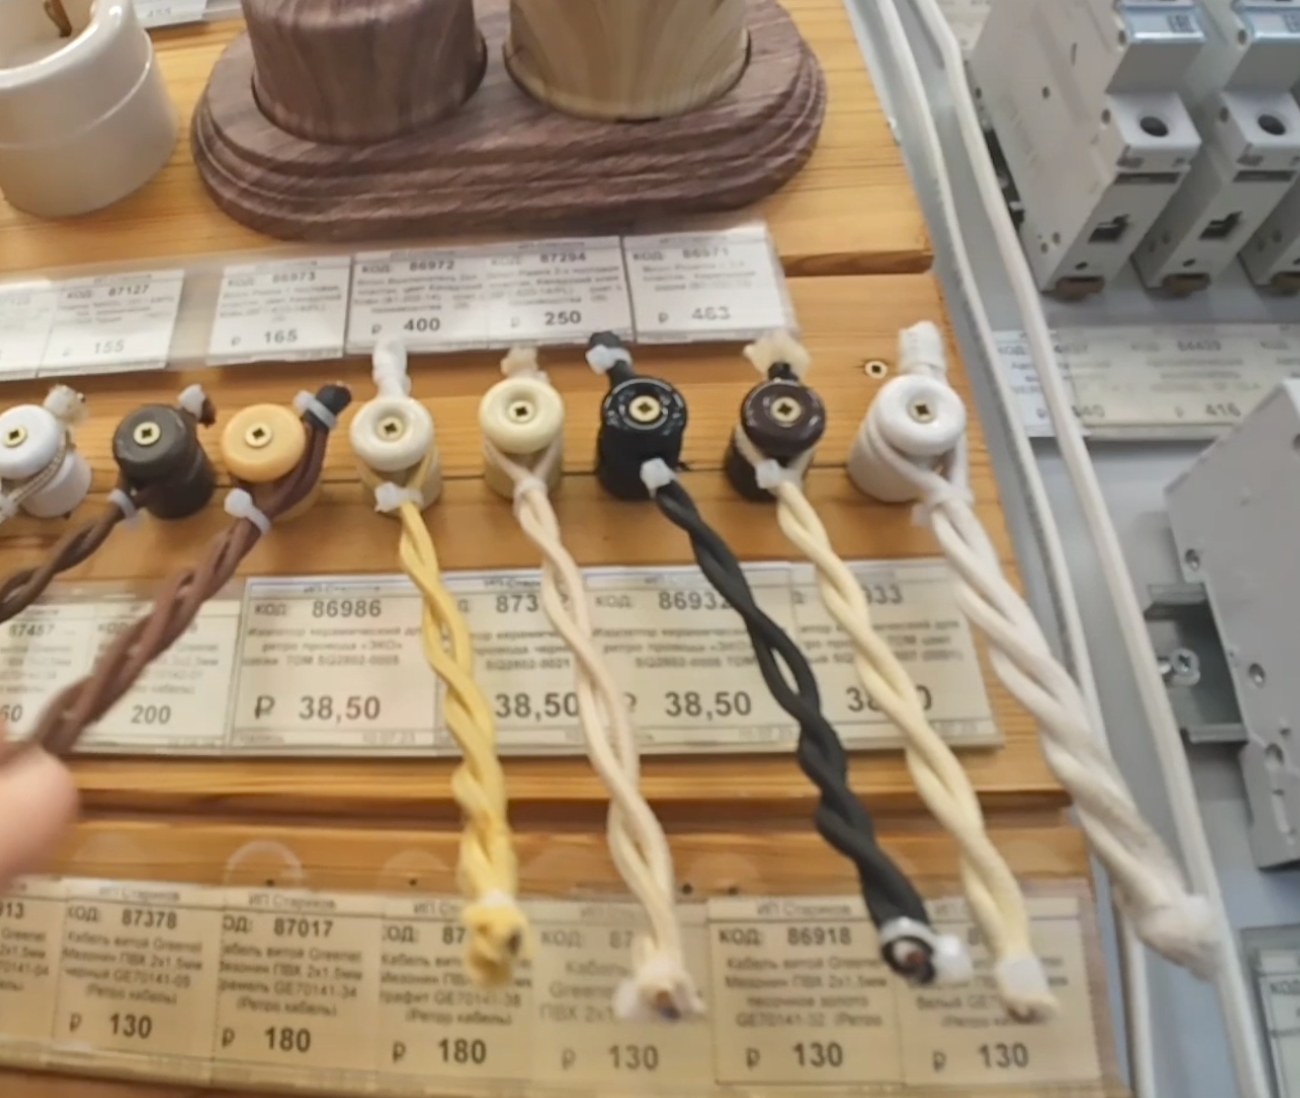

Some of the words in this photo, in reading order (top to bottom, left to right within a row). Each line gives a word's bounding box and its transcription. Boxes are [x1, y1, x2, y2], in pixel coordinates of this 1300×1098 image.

[403, 317, 441, 332] 400
[544, 310, 582, 326] 250
[265, 329, 298, 344] 165
[312, 599, 382, 618] 86986
[131, 706, 172, 724] 200
[299, 695, 380, 724] 38,50
[496, 692, 579, 722] 38,50
[665, 691, 752, 720] 38,50
[121, 907, 178, 930] 87378
[273, 917, 334, 938] 87017
[786, 927, 852, 945] 86918
[110, 1012, 152, 1040] 130
[264, 1026, 312, 1053] 180
[438, 1038, 487, 1065] 180
[608, 1043, 660, 1071] 130
[792, 1041, 844, 1068] 130
[977, 1042, 1029, 1069] 130
